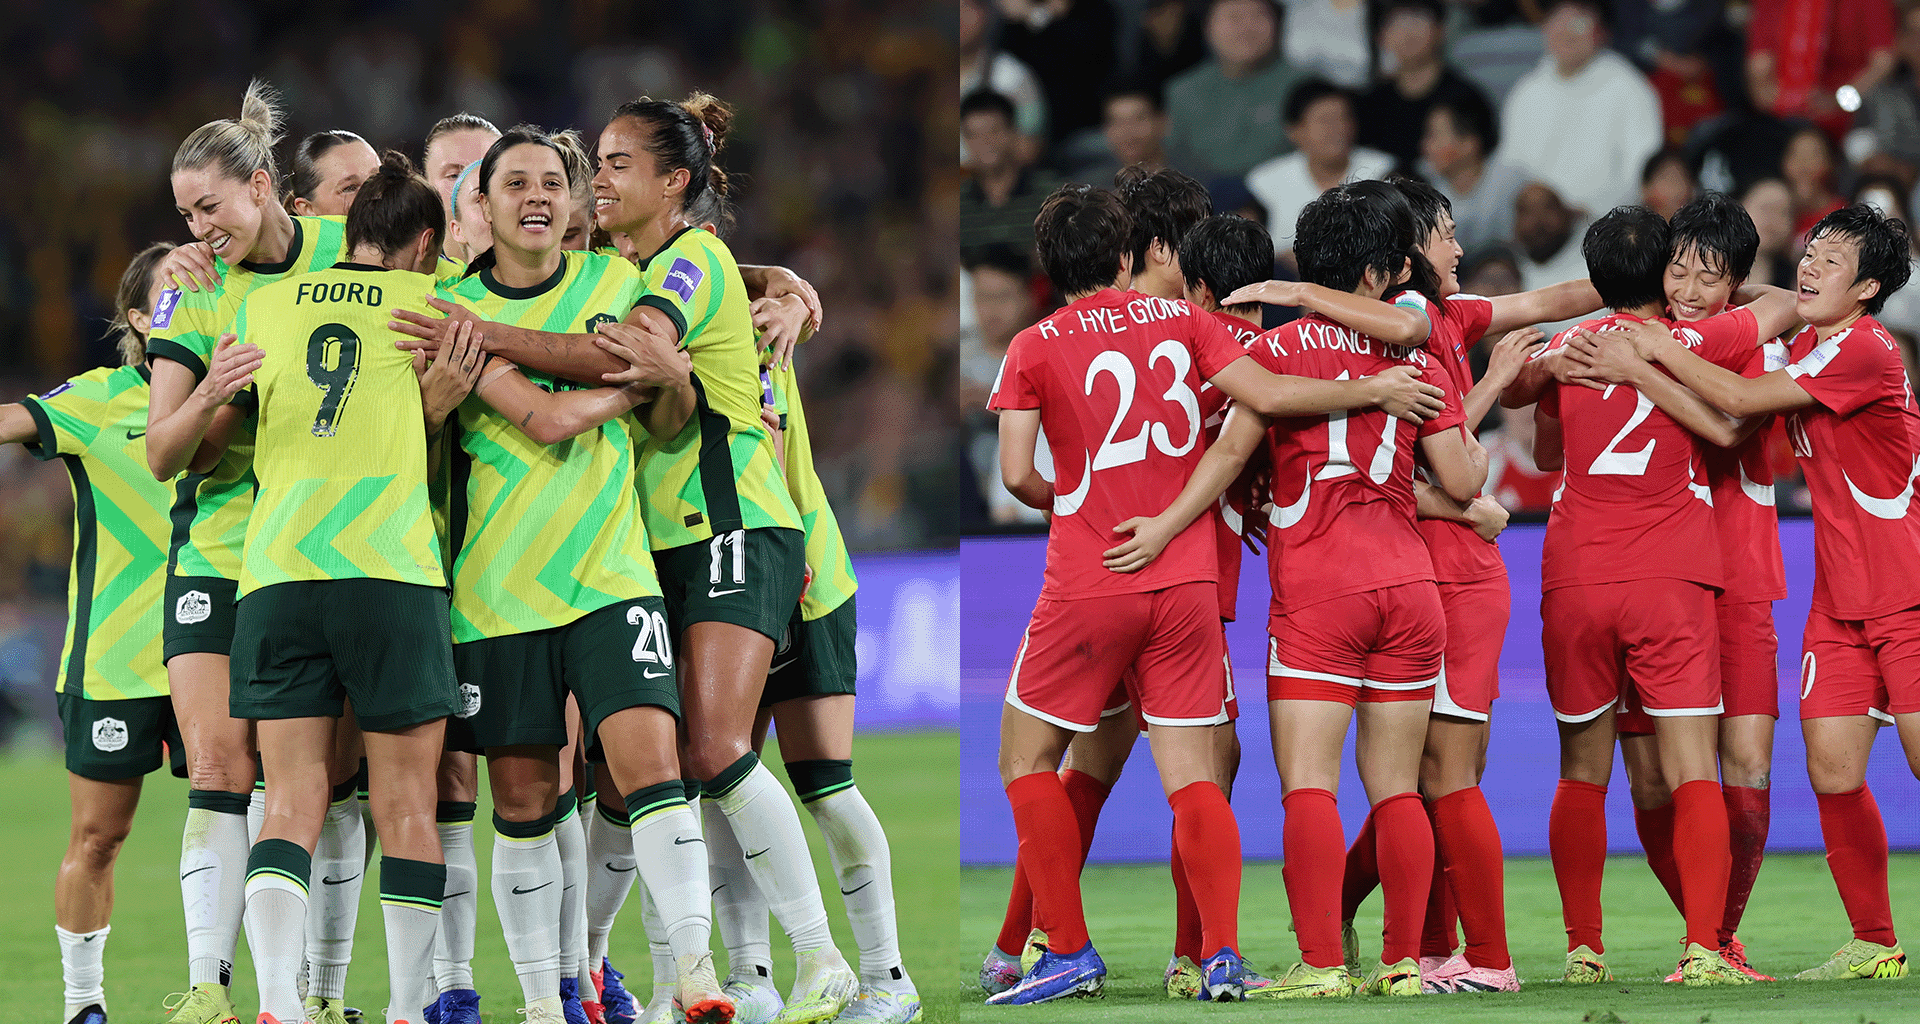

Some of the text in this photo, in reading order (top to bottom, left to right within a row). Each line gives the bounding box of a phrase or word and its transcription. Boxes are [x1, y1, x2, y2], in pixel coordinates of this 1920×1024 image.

[296, 282, 383, 307] FOORD
[1076, 307, 1128, 334] HYE
[1127, 296, 1191, 324] GYONG
[1297, 322, 1371, 355] KYONG
[306, 323, 362, 437] 9
[1084, 339, 1201, 472] 23
[1587, 383, 1657, 476] 2
[710, 529, 746, 584] 11
[626, 605, 673, 670] 20
